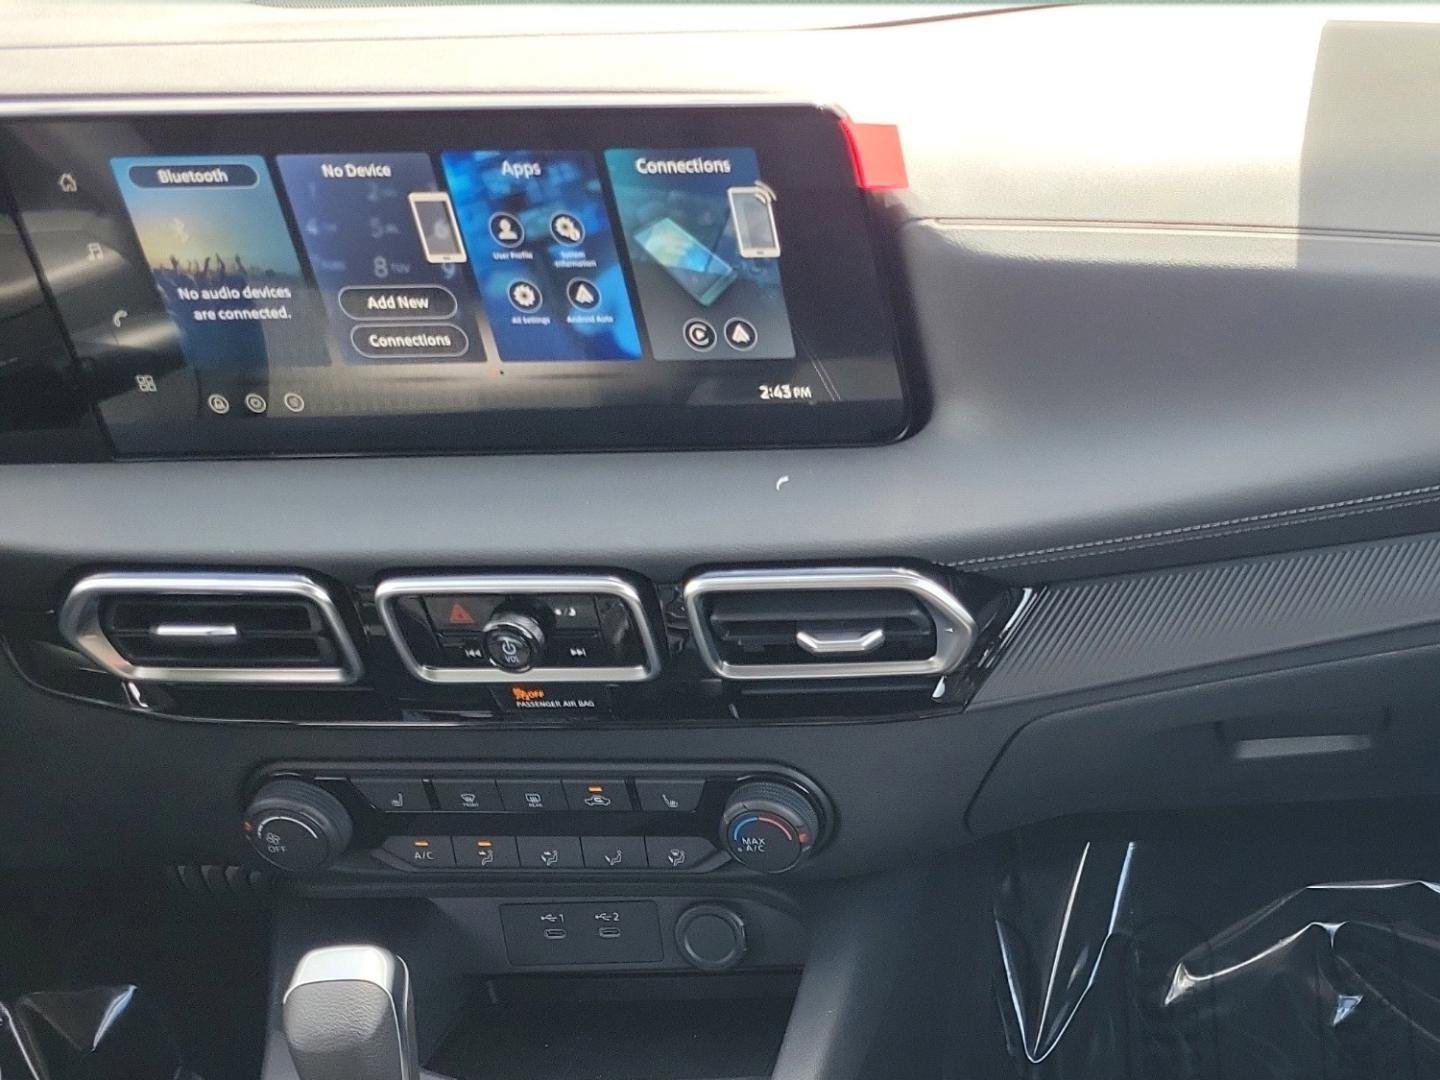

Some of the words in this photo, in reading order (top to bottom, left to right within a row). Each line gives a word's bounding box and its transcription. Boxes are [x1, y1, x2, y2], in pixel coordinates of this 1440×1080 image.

[321, 164, 343, 178] No
[346, 163, 391, 178] Device
[501, 161, 541, 178] Apps
[635, 157, 731, 174] Connections
[157, 168, 228, 185] Bluetooth
[374, 255, 388, 278] 8
[177, 287, 200, 301] No
[202, 286, 240, 301] audio
[242, 286, 292, 301] devices
[368, 295, 393, 311] Add
[395, 295, 429, 310] New
[194, 308, 216, 321] are
[218, 305, 292, 321] connected.
[369, 333, 451, 348] Connections
[759, 386, 792, 399] 2:43
[793, 387, 811, 399] PM
[504, 655, 520, 664] VOL
[563, 700, 577, 708] AIR
[578, 700, 595, 708] BAG
[742, 836, 766, 847] MAX
[746, 843, 766, 853] A/C
[267, 843, 287, 855] OFF
[413, 850, 435, 862] A/C
[558, 913, 565, 923] 1
[610, 912, 620, 922] 2
